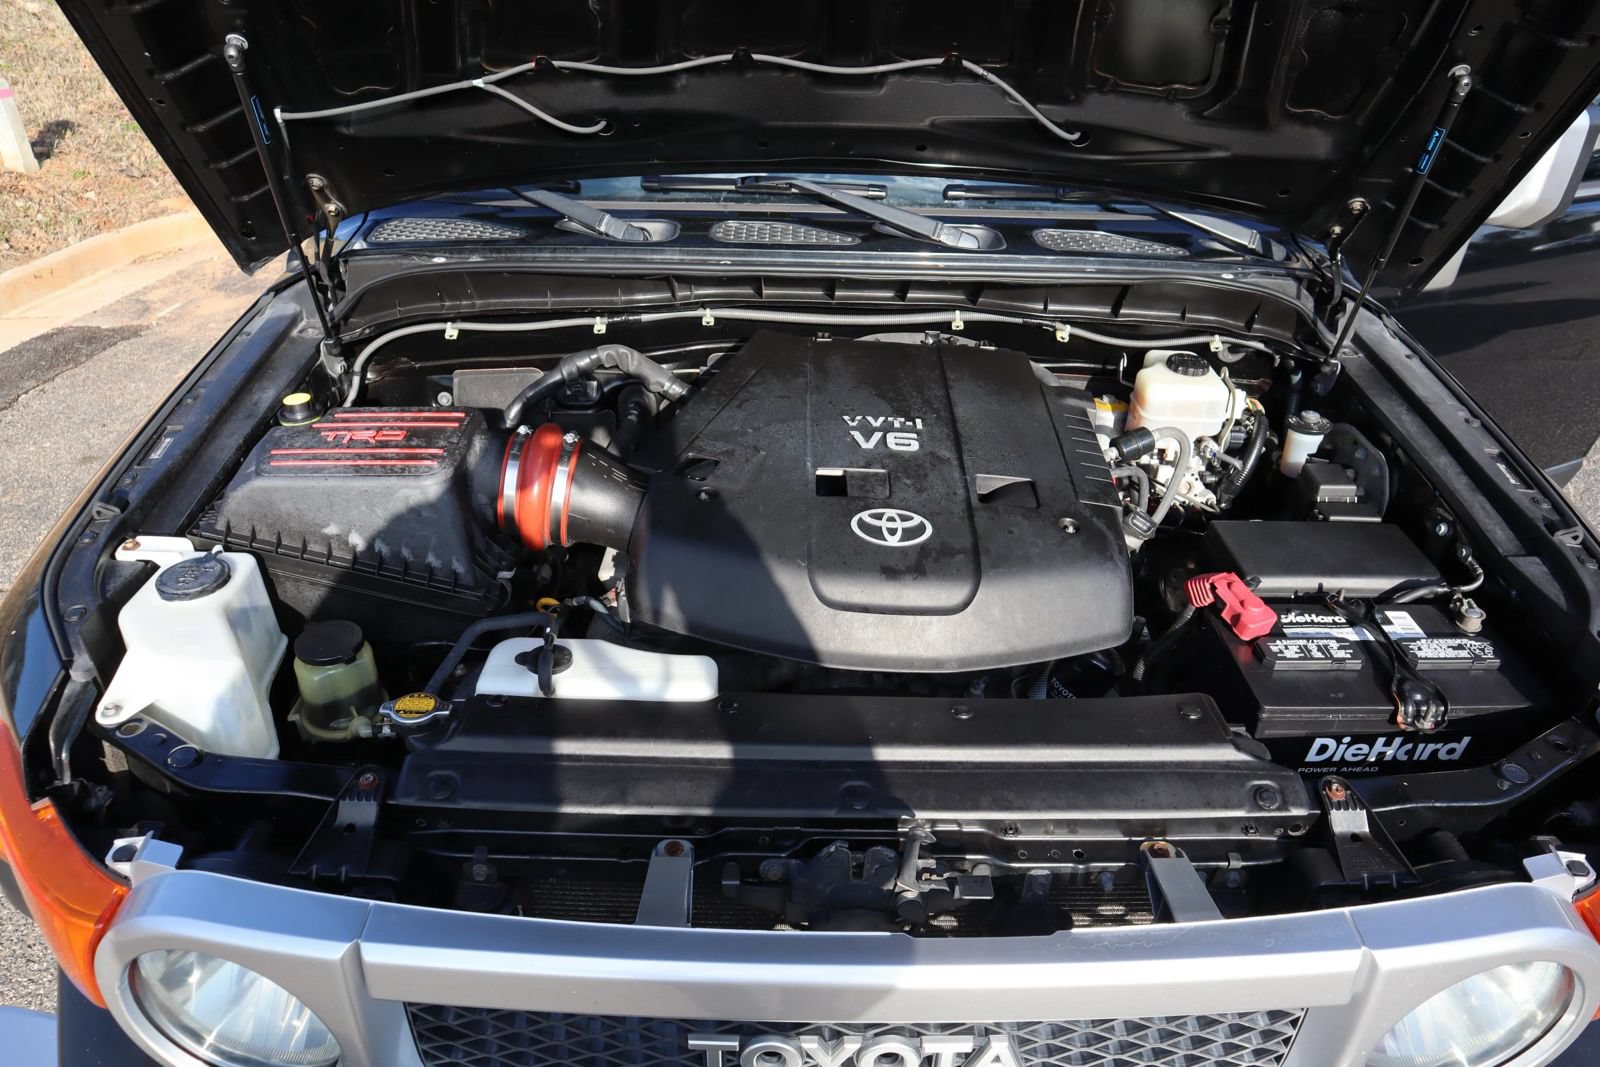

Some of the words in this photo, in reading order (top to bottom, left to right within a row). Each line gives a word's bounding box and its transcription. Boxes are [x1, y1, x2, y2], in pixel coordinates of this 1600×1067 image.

[849, 430, 920, 452] V6
[1304, 736, 1473, 763] DieHard
[1297, 766, 1337, 774] POWER
